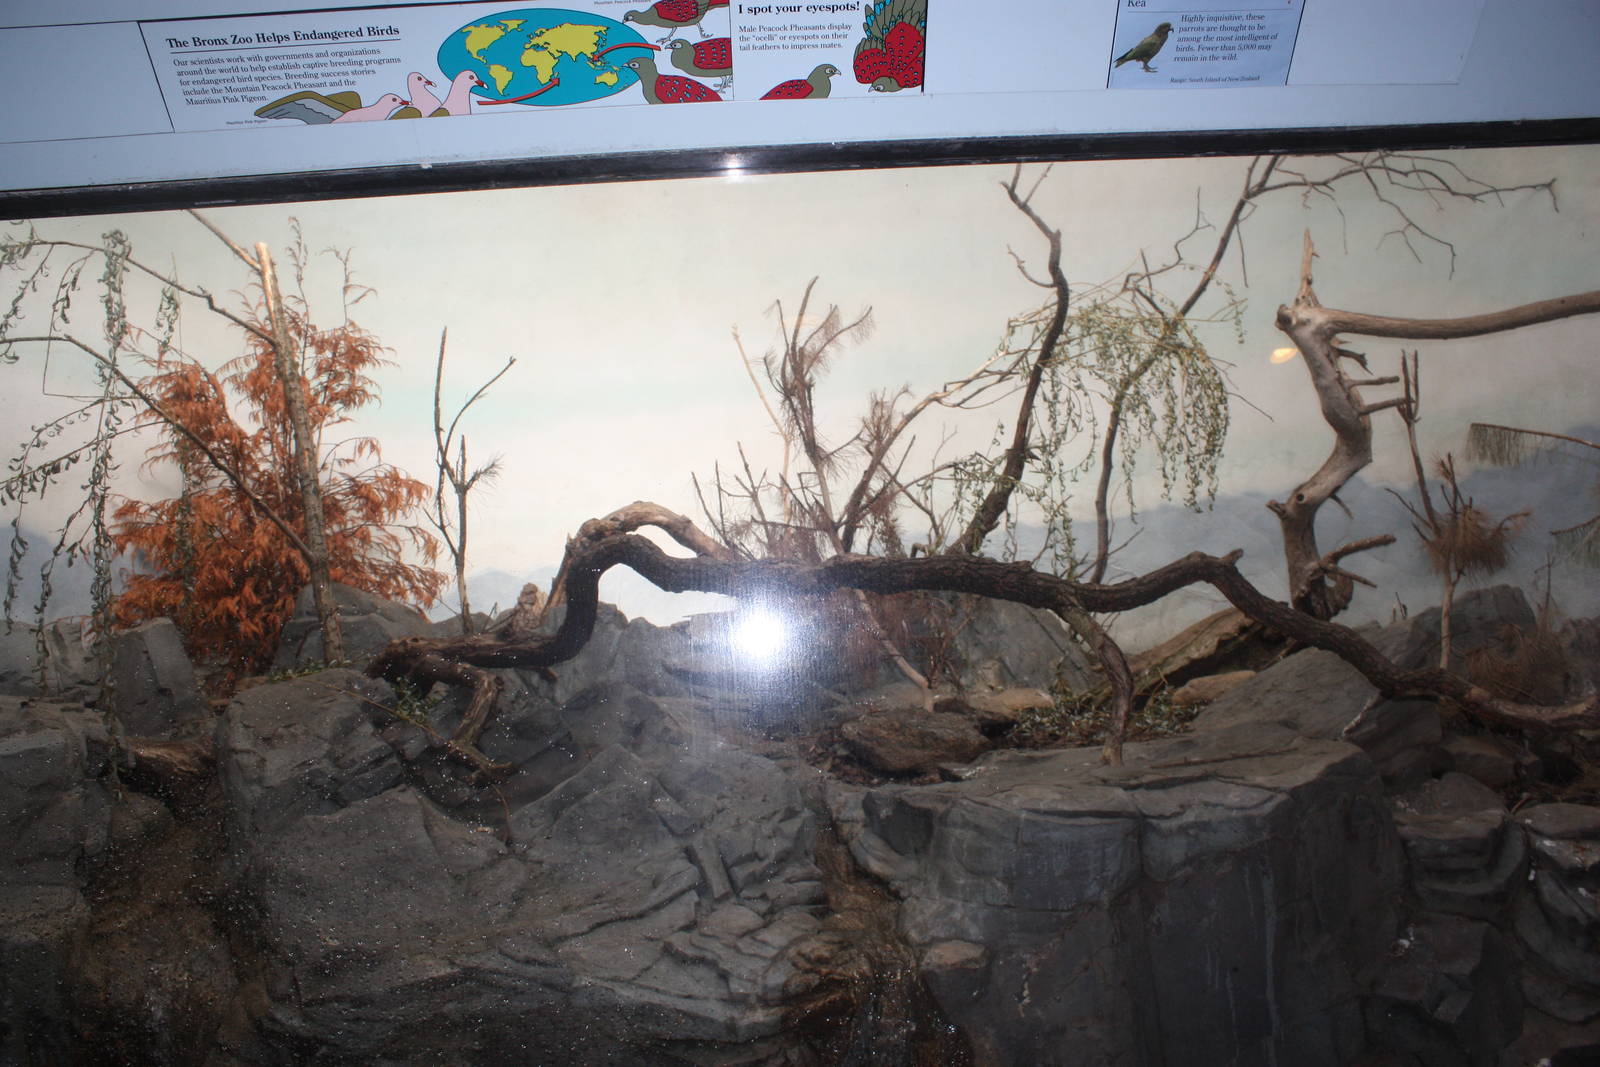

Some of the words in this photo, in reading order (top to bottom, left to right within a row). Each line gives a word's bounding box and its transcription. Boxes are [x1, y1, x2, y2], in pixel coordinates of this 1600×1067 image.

[738, 4, 743, 14] I
[747, 5, 772, 15] spot
[775, 5, 802, 15] your
[806, 1, 860, 14] eyespots!
[1181, 14, 1204, 23] Highly
[739, 25, 757, 33] Male
[759, 24, 788, 32] Peacock
[827, 23, 852, 31] display
[1220, 24, 1247, 32] thought
[166, 38, 188, 48] The
[192, 36, 228, 47] Bronx
[230, 34, 253, 45] Zoo
[256, 32, 290, 44] Helps
[293, 27, 363, 41] Endangered
[367, 25, 400, 37] Birds
[788, 33, 820, 41] eyespots
[1235, 33, 1269, 42] intelligent
[790, 42, 819, 51] impress
[173, 58, 188, 67] Our
[190, 56, 225, 66] scientists
[246, 54, 264, 62] with
[264, 52, 314, 63] governments
[315, 50, 329, 58] and
[331, 48, 381, 58] organizations
[177, 68, 203, 77] around
[204, 67, 217, 75] the
[218, 65, 239, 74] world
[250, 64, 267, 73] help
[268, 62, 301, 71] establish
[302, 61, 328, 70] captive
[330, 58, 363, 67] breeding
[365, 57, 401, 66] programs
[180, 79, 191, 87] for
[192, 76, 236, 86] endangered
[254, 75, 282, 84] species.
[284, 71, 319, 80] Breeding
[183, 88, 210, 96] include
[211, 86, 224, 94] the
[224, 85, 261, 94] Mountain
[261, 82, 292, 91] Peacock
[294, 81, 327, 89] Pheasant
[344, 78, 357, 86] the
[185, 98, 221, 106] Mauritius
[240, 94, 269, 103] Pigeon.
